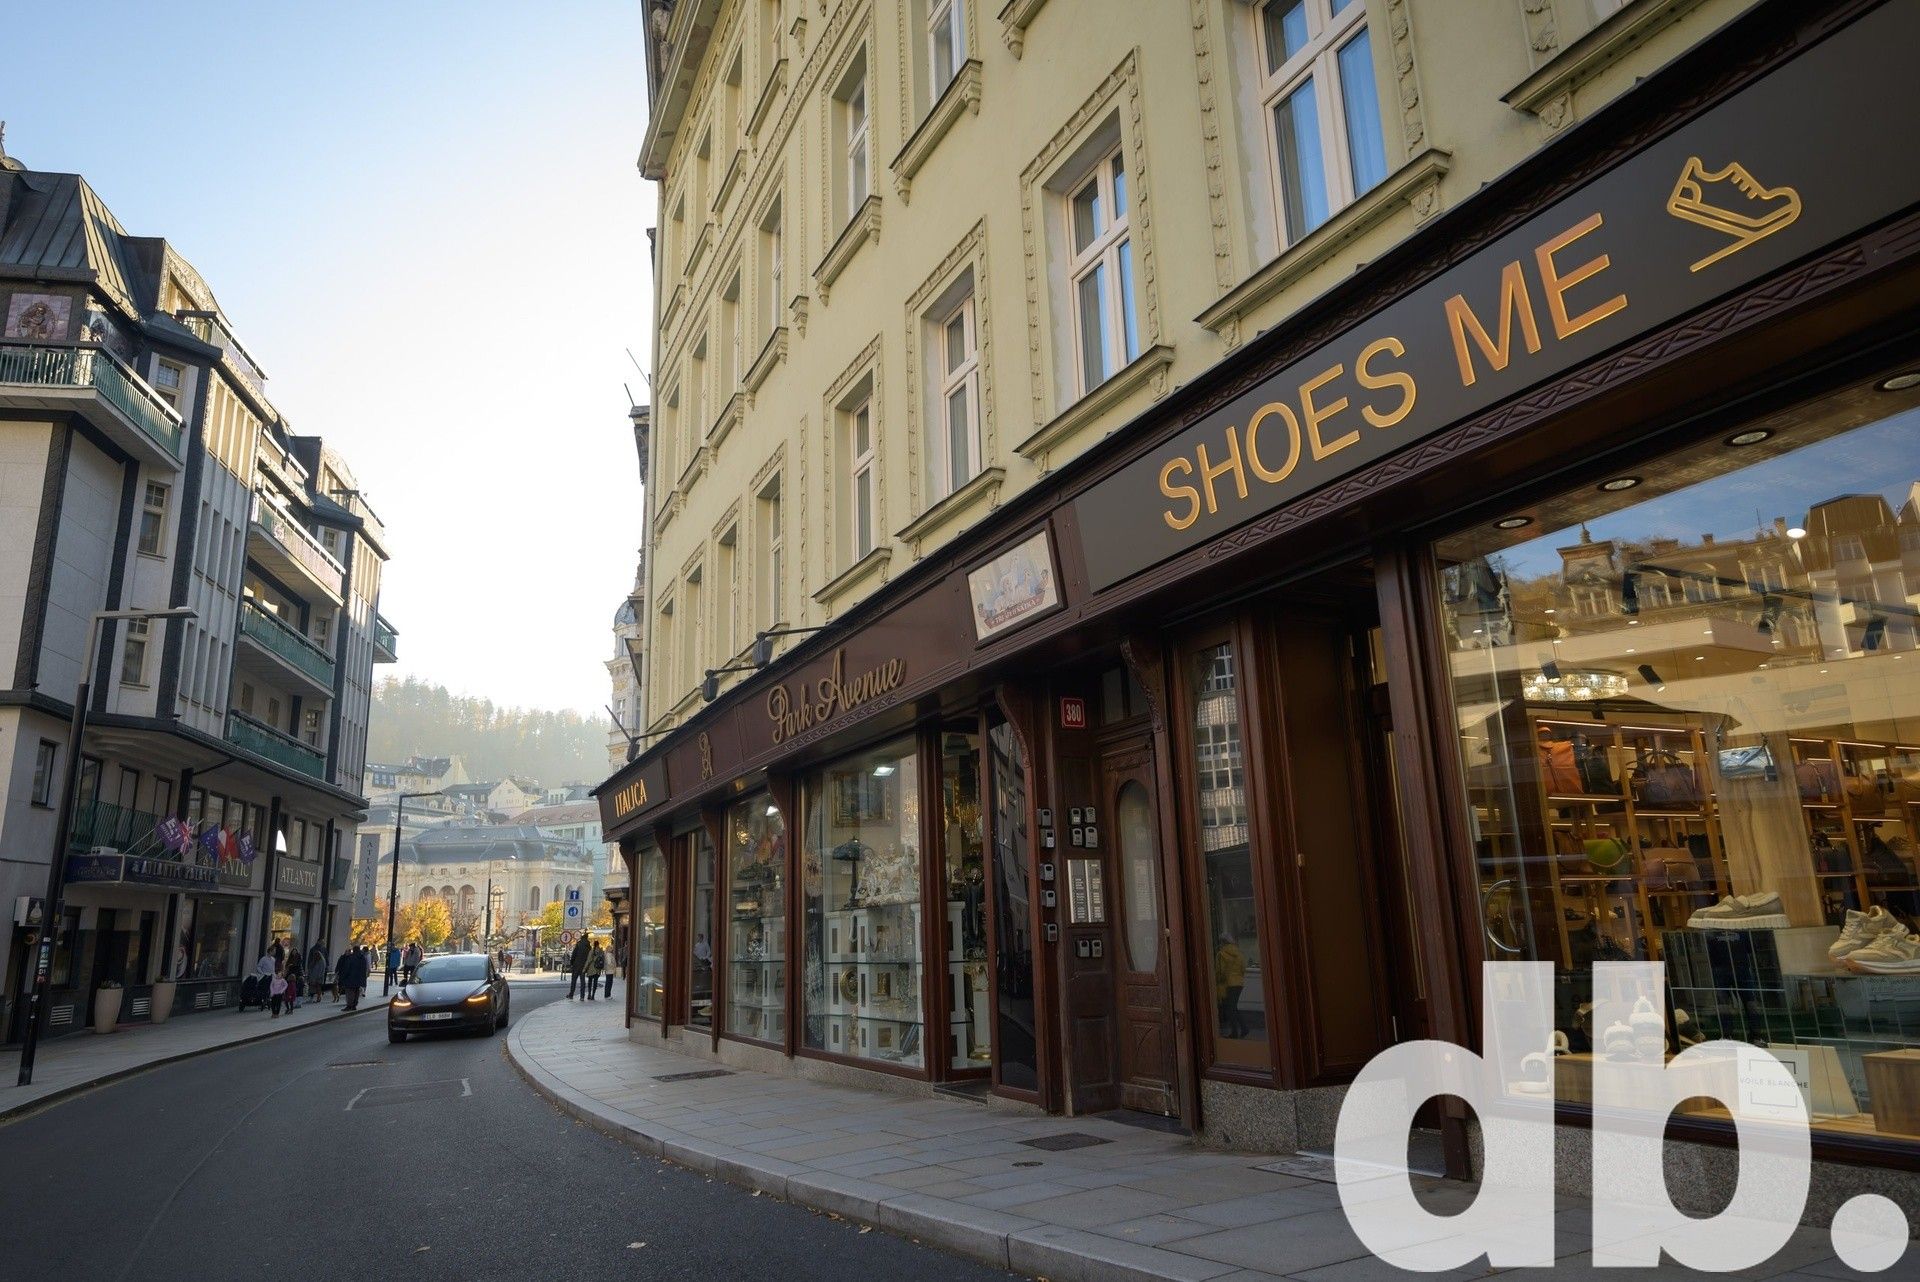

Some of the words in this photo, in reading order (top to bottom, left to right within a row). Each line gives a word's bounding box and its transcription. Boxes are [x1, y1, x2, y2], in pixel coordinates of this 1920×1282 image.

[1158, 336, 1417, 532] SHOES
[1444, 212, 1628, 387] ME
[767, 683, 813, 745] Park
[815, 648, 907, 722] Avenue
[1066, 703, 1082, 722] 380
[614, 778, 648, 818] ITALICA
[281, 865, 317, 888] ATLANTIC
[362, 840, 374, 905] ATLANTIC
